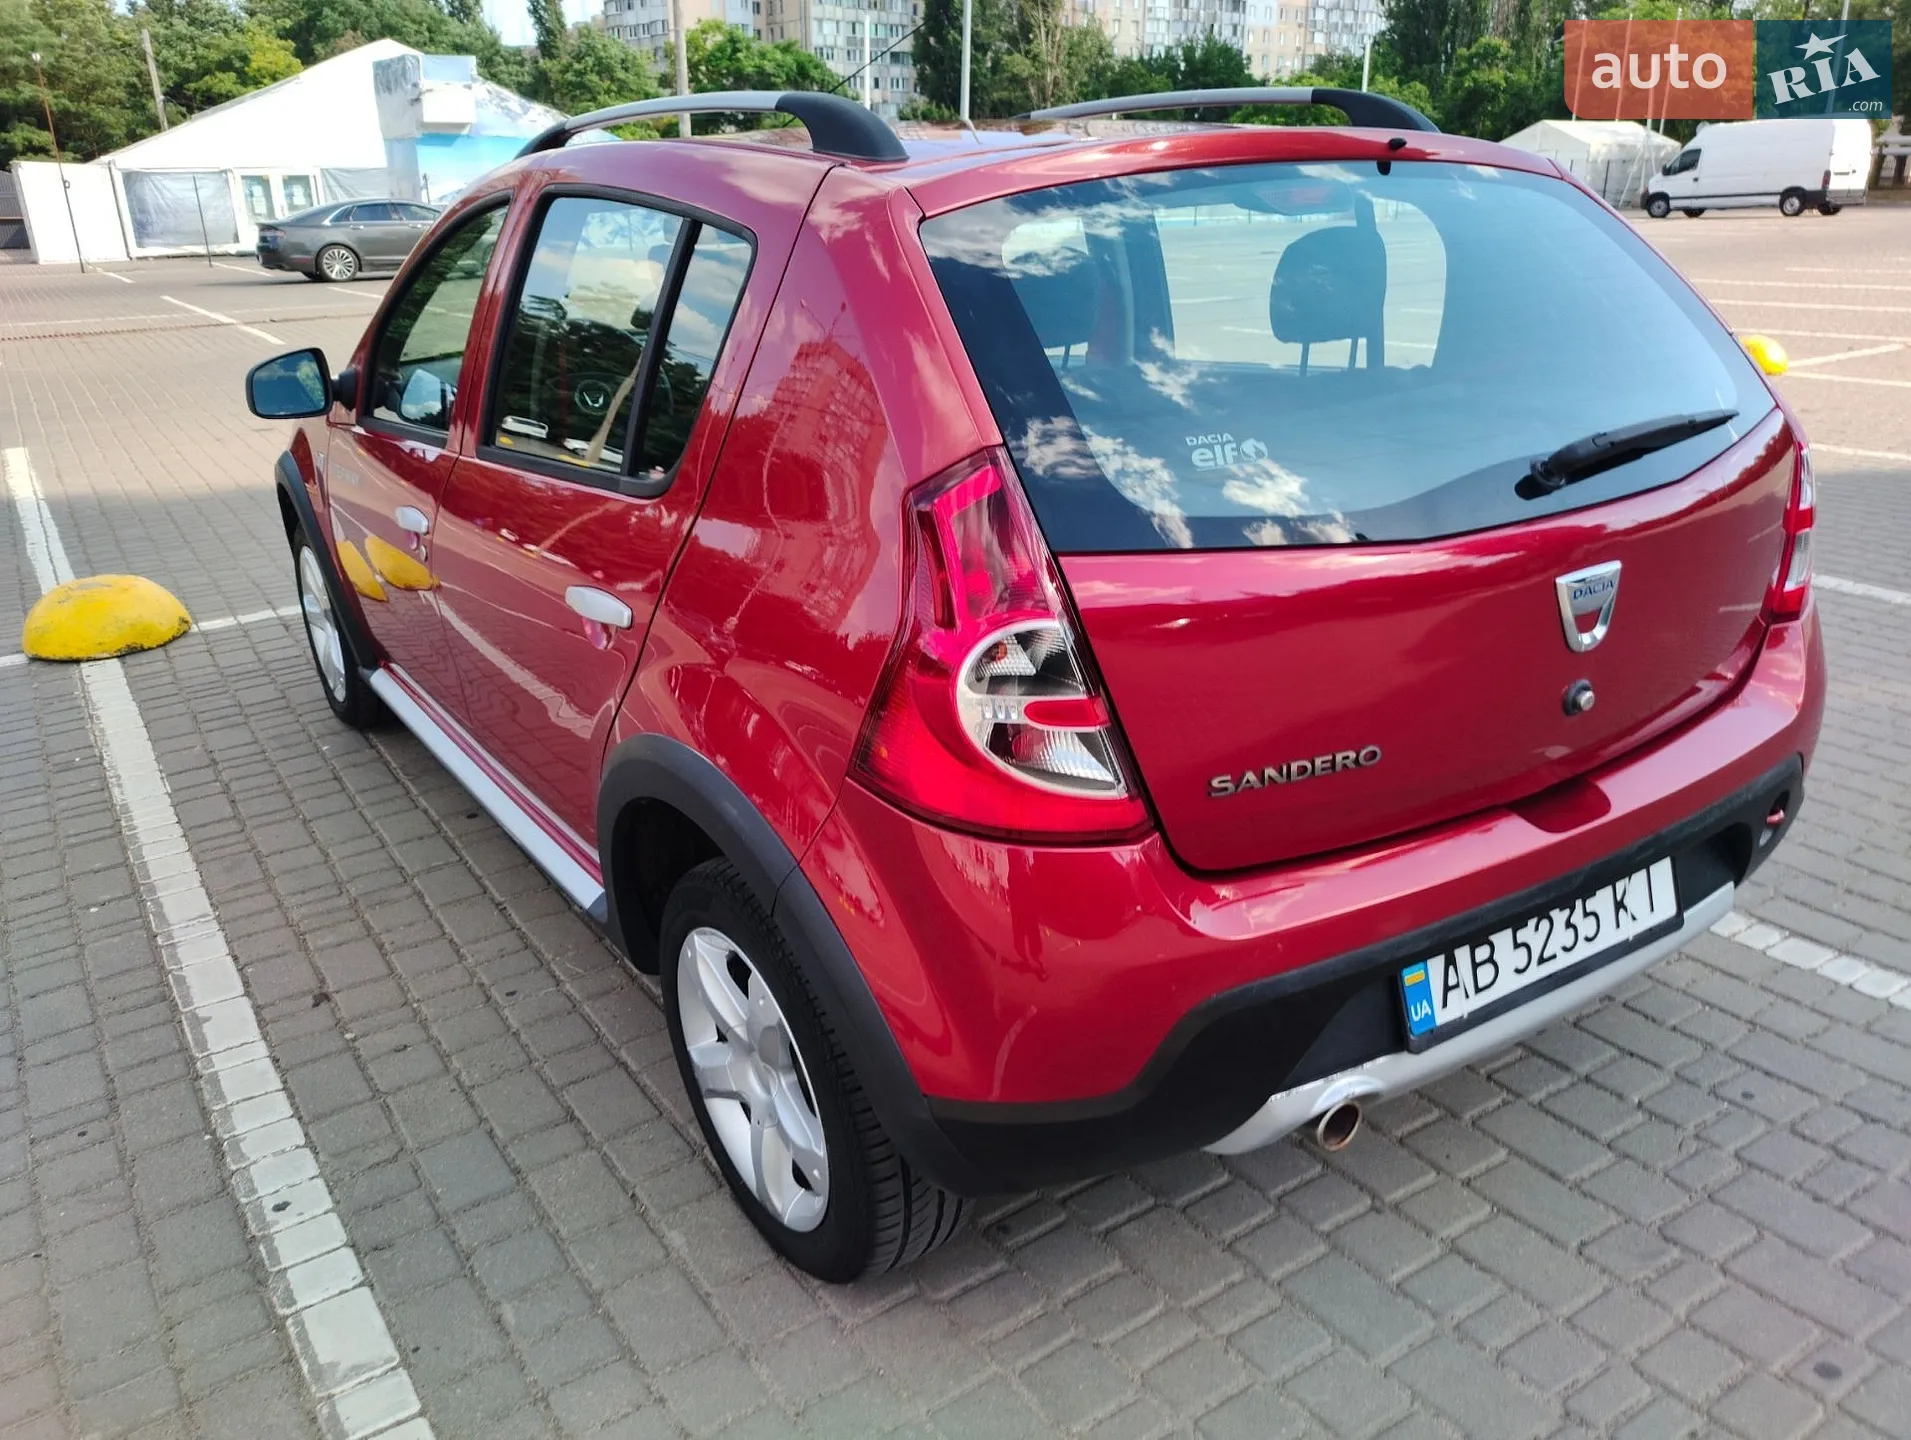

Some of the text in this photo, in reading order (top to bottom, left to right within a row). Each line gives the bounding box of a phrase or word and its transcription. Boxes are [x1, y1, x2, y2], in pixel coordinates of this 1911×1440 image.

[1185, 433, 1234, 446] DACIA
[1191, 442, 1238, 468] elf
[1573, 580, 1614, 600] DACIA
[1209, 745, 1382, 797] SANDERO
[1441, 939, 1500, 1009] AB
[1511, 893, 1601, 975] 5235
[1410, 1003, 1432, 1022] UA
